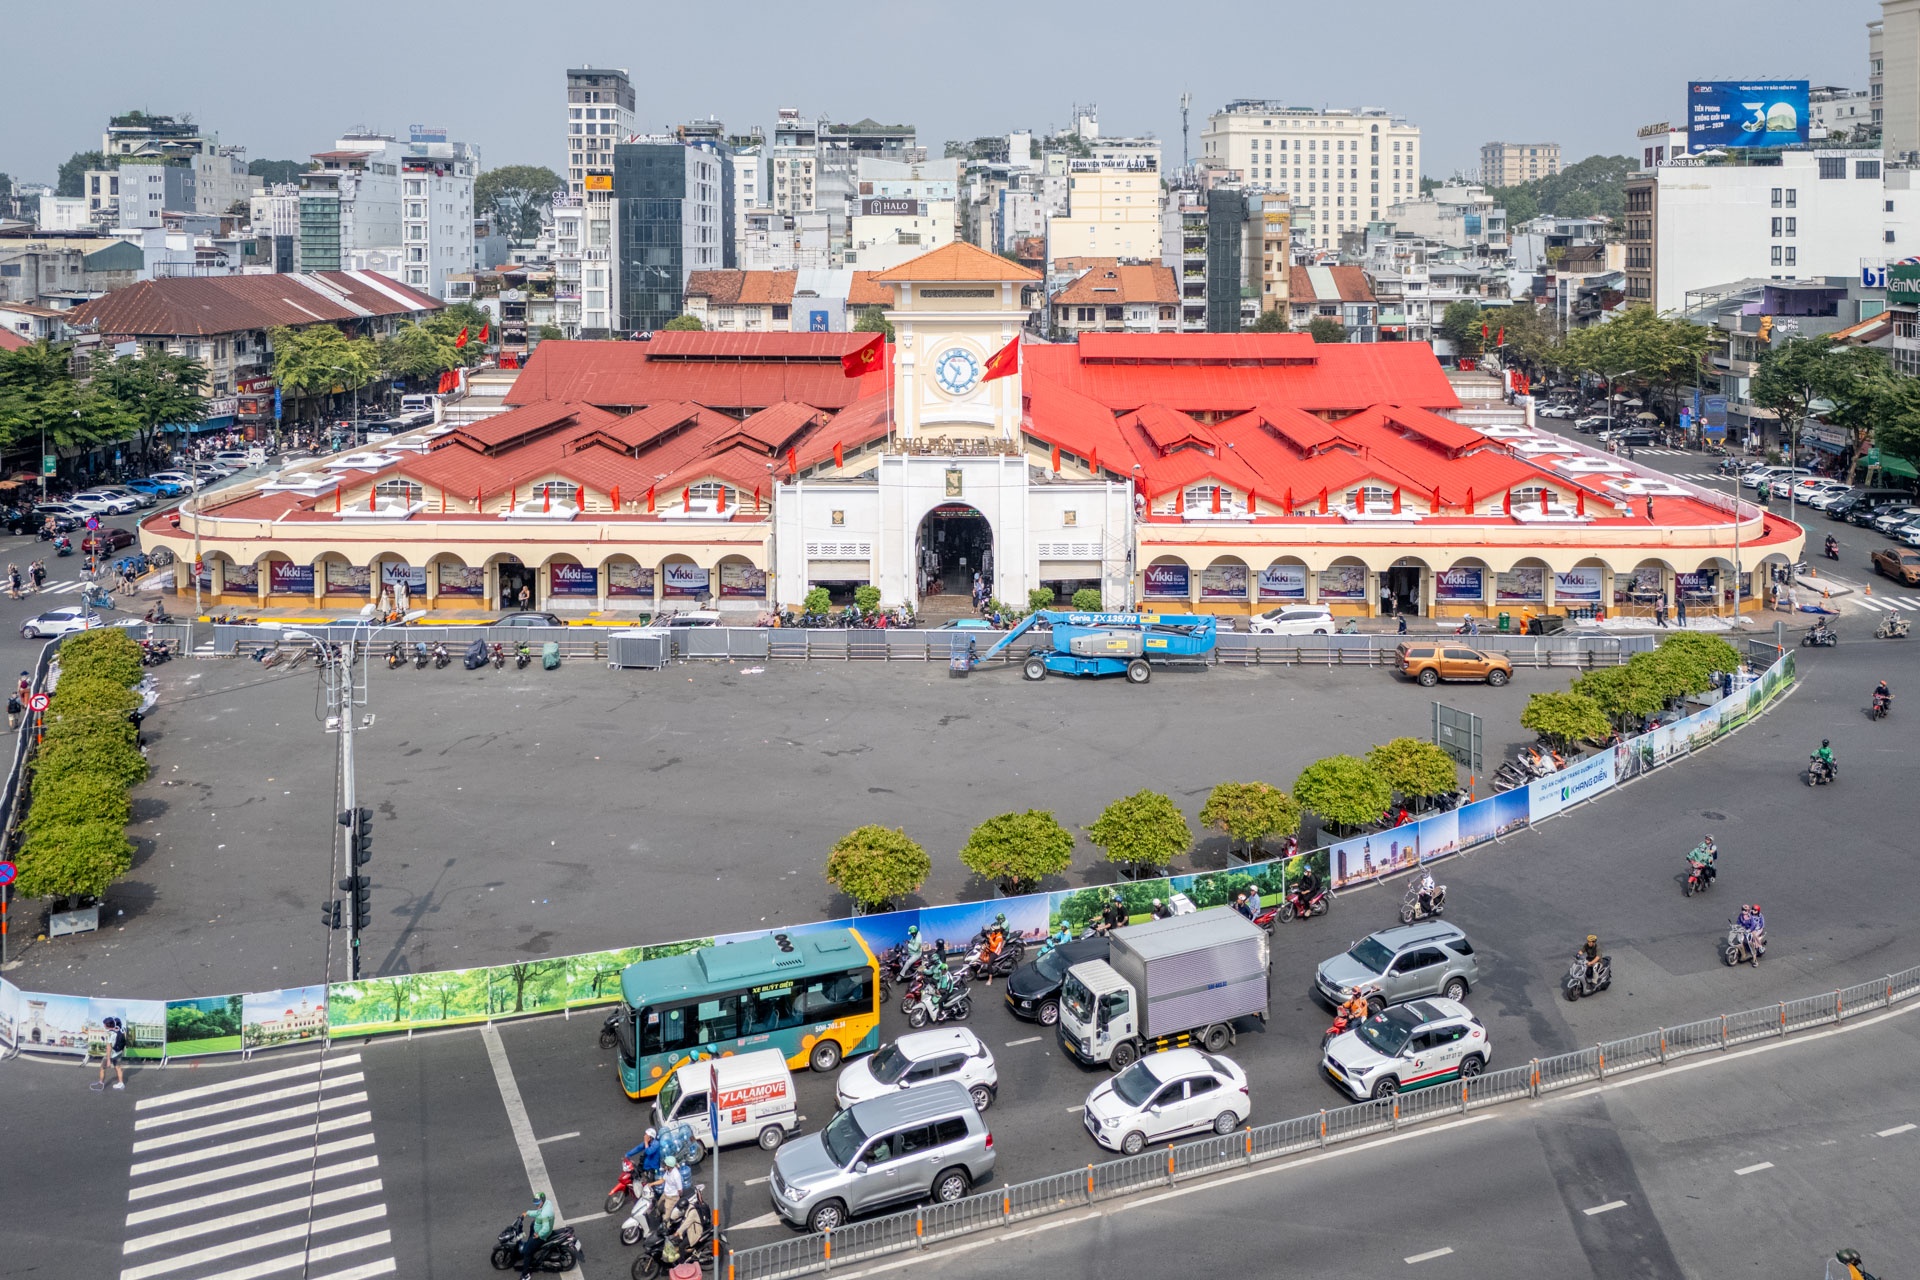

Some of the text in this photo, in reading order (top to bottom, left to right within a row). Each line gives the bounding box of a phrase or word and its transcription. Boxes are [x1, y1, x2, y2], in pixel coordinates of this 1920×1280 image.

[1657, 159, 1705, 167] OZONE BAR
[883, 202, 909, 210] HALO
[812, 323, 826, 332] PNJ
[893, 434, 1016, 452] CHỢ BẾN THÀNH
[275, 562, 300, 577] Vikki
[385, 563, 410, 577] Vikki
[555, 564, 581, 579] Vikki
[667, 565, 693, 579] Vikki
[1147, 567, 1173, 582] Vikki
[1262, 568, 1288, 582] Vikki
[1439, 569, 1465, 584] Vikki
[1558, 572, 1584, 585] Vikki
[1069, 614, 1091, 622] Genie
[1106, 615, 1137, 623] 135/70
[1571, 768, 1607, 795] KHANG ĐIỀN
[761, 984, 778, 992] BUÝT
[730, 1082, 785, 1102] LALAMOVE
